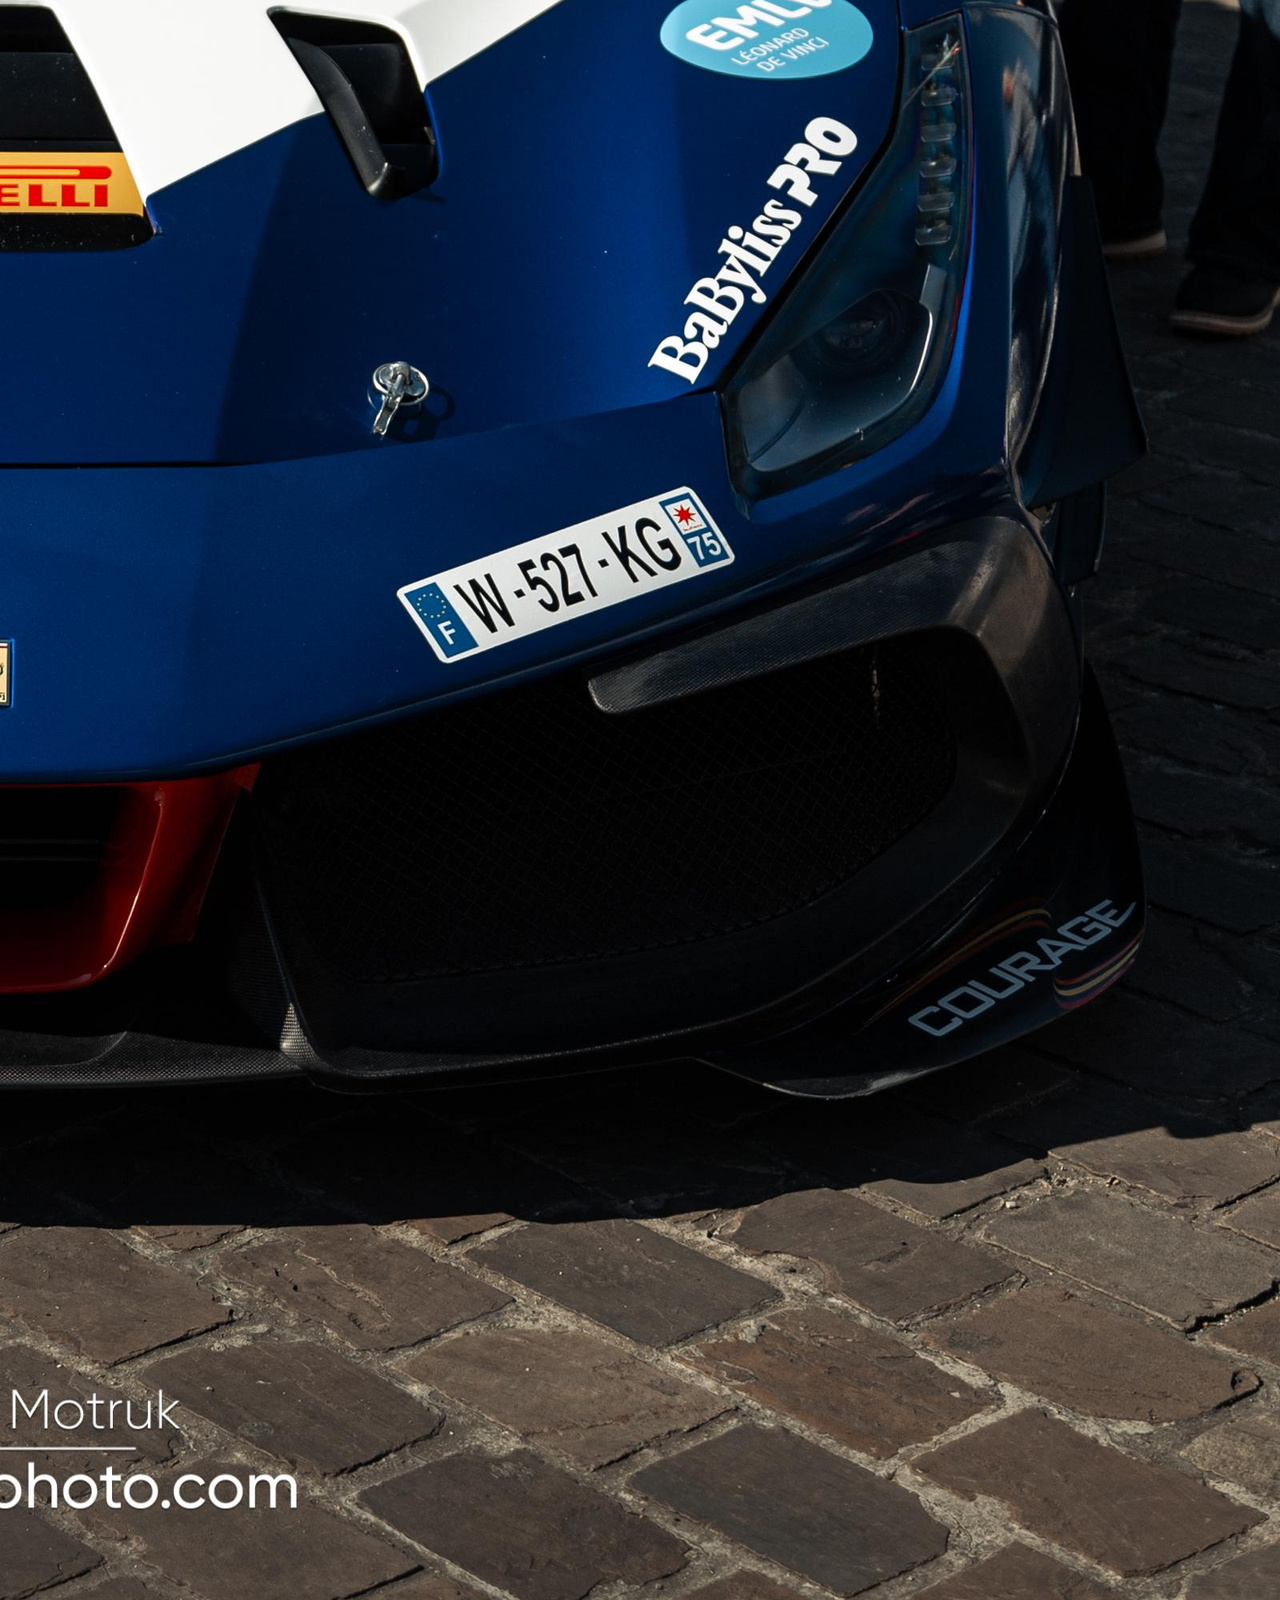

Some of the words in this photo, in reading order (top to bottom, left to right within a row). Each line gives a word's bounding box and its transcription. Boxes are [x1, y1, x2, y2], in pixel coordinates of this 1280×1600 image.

[731, 27, 809, 66] LÉONARD
[756, 55, 786, 73] DE
[780, 36, 829, 61] VINCI
[647, 198, 803, 385] BaByliss
[766, 116, 858, 207] PRO
[437, 620, 456, 646] F
[686, 531, 722, 560] 75
[908, 899, 1136, 1037] COURAGE
